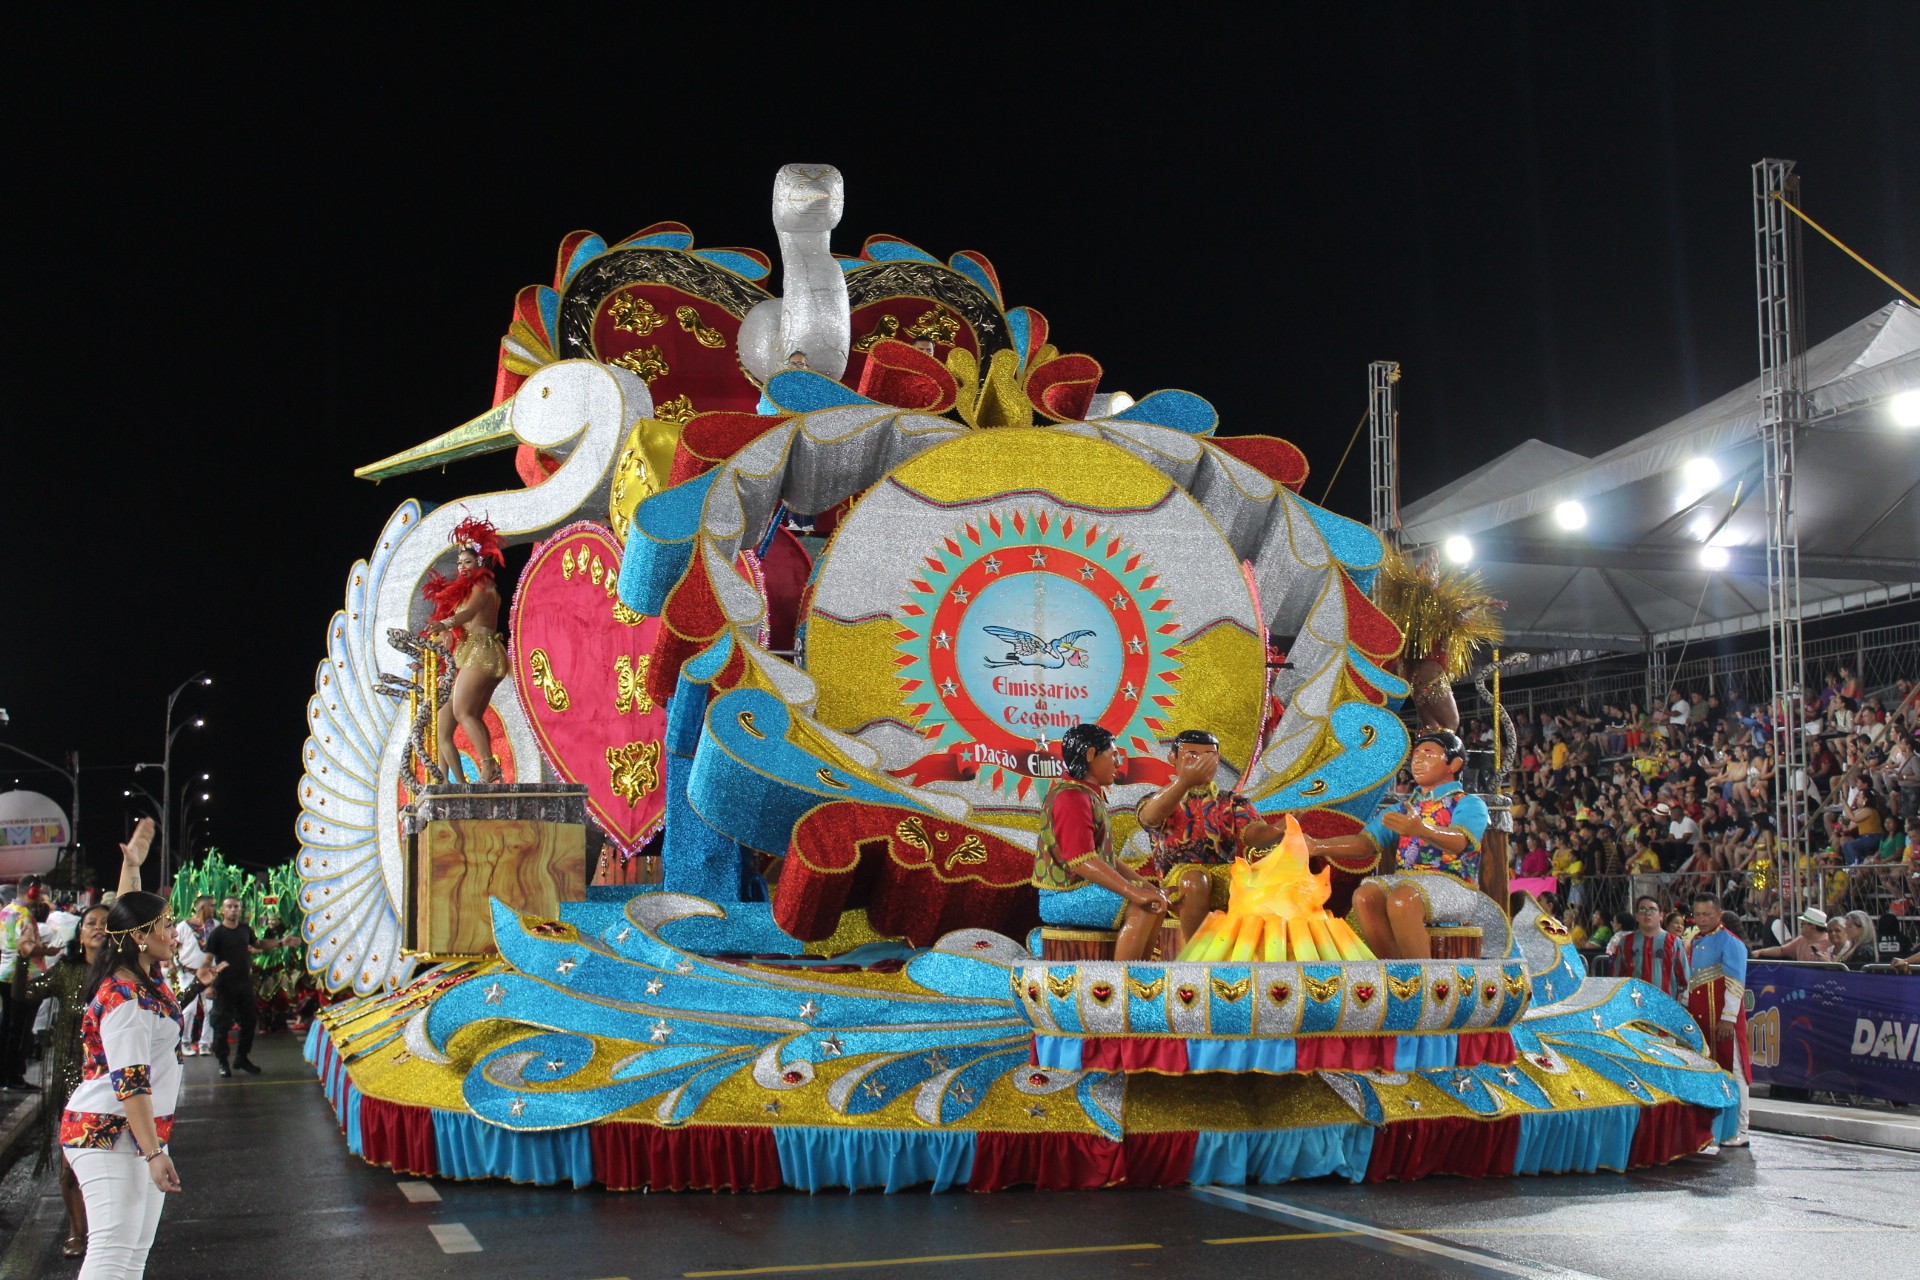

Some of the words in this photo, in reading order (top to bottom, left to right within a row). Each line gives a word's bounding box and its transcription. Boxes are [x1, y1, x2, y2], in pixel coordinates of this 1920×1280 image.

[992, 675, 1089, 700] Emissarios
[1003, 705, 1081, 729] Cegonha
[1035, 699, 1048, 711] da
[975, 743, 1018, 770] Nação
